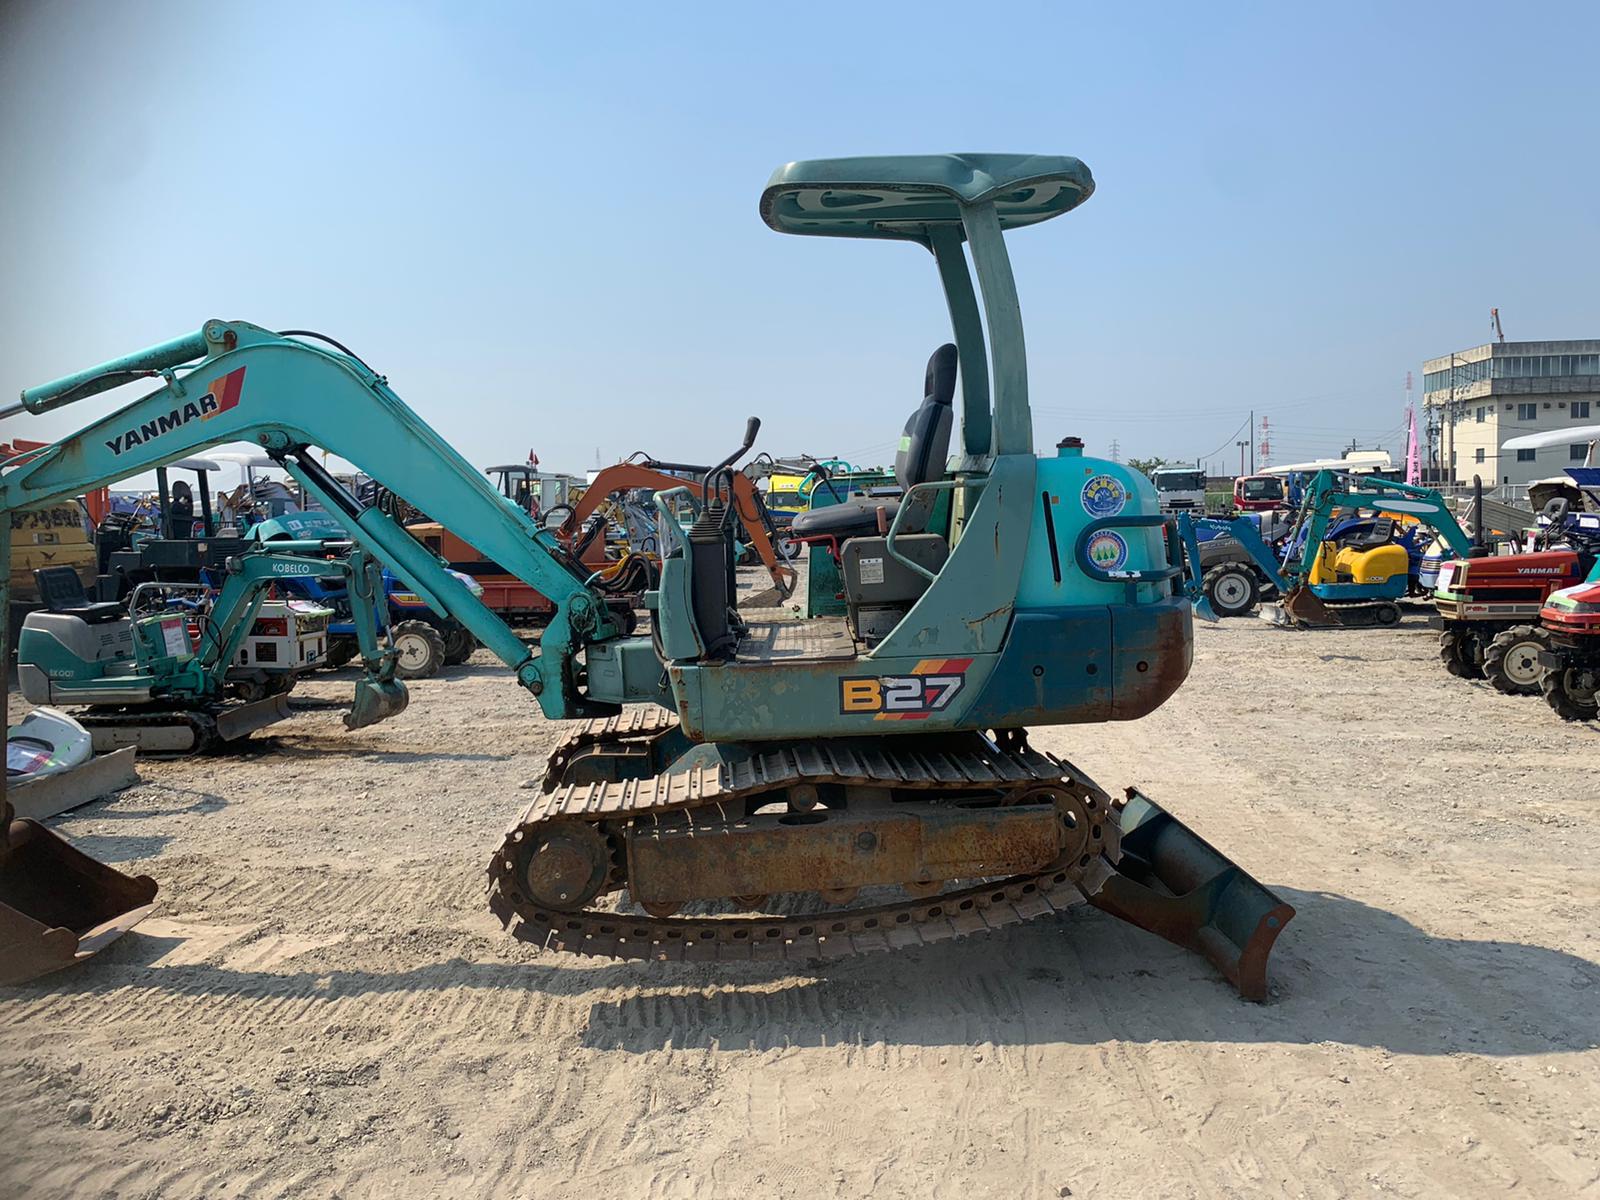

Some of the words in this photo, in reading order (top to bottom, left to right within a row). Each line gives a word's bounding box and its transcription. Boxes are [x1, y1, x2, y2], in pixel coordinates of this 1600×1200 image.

[104, 391, 219, 456] YANMAR
[272, 563, 310, 574] KOBELCO
[842, 676, 962, 712] B27
